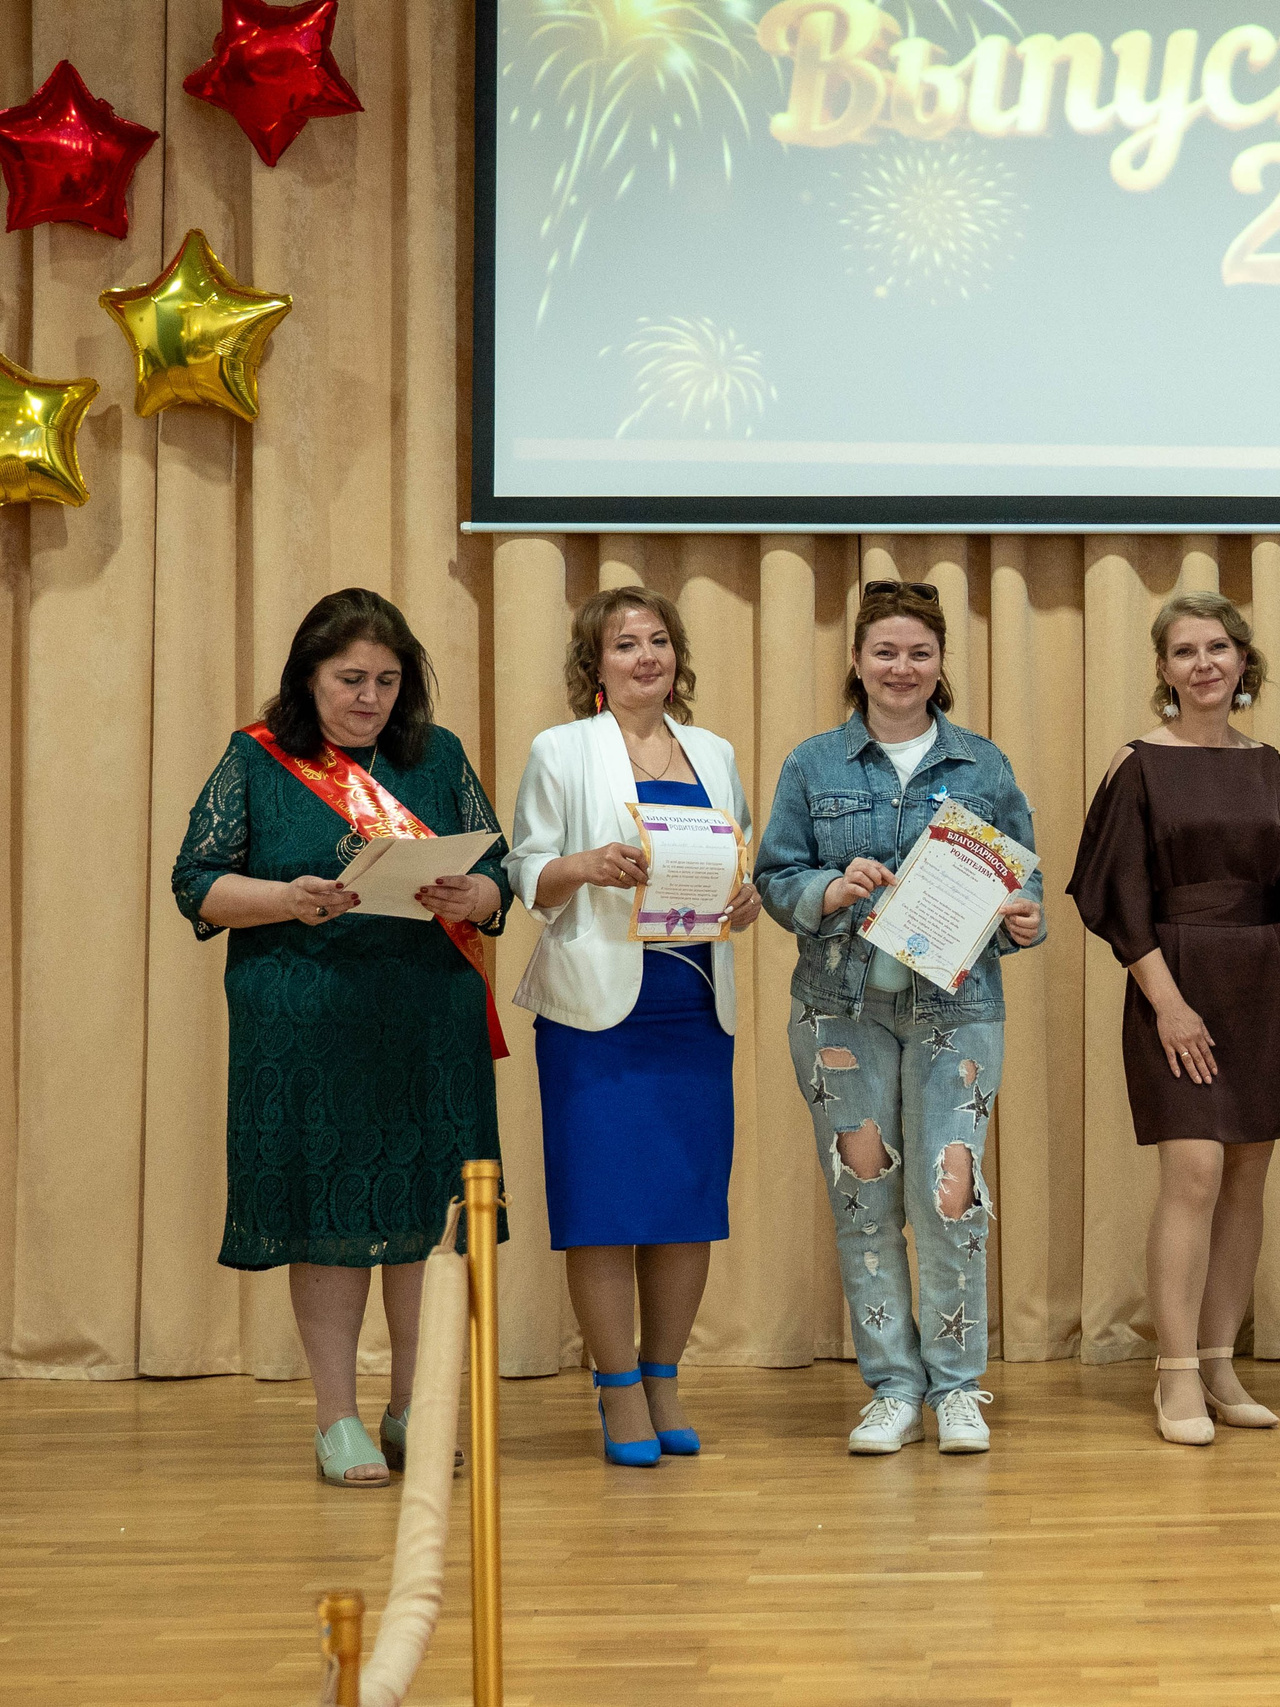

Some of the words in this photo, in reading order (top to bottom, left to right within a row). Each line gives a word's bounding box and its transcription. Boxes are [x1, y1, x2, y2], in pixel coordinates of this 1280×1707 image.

[646, 816, 725, 825] БЛАГОДАРНОСТЬ
[669, 824, 710, 832] РОДИТЕЛЯМ
[947, 831, 1009, 877] БЛАГОДАРНОСТЬ
[950, 847, 993, 879] РОДИТЕЛЯМ
